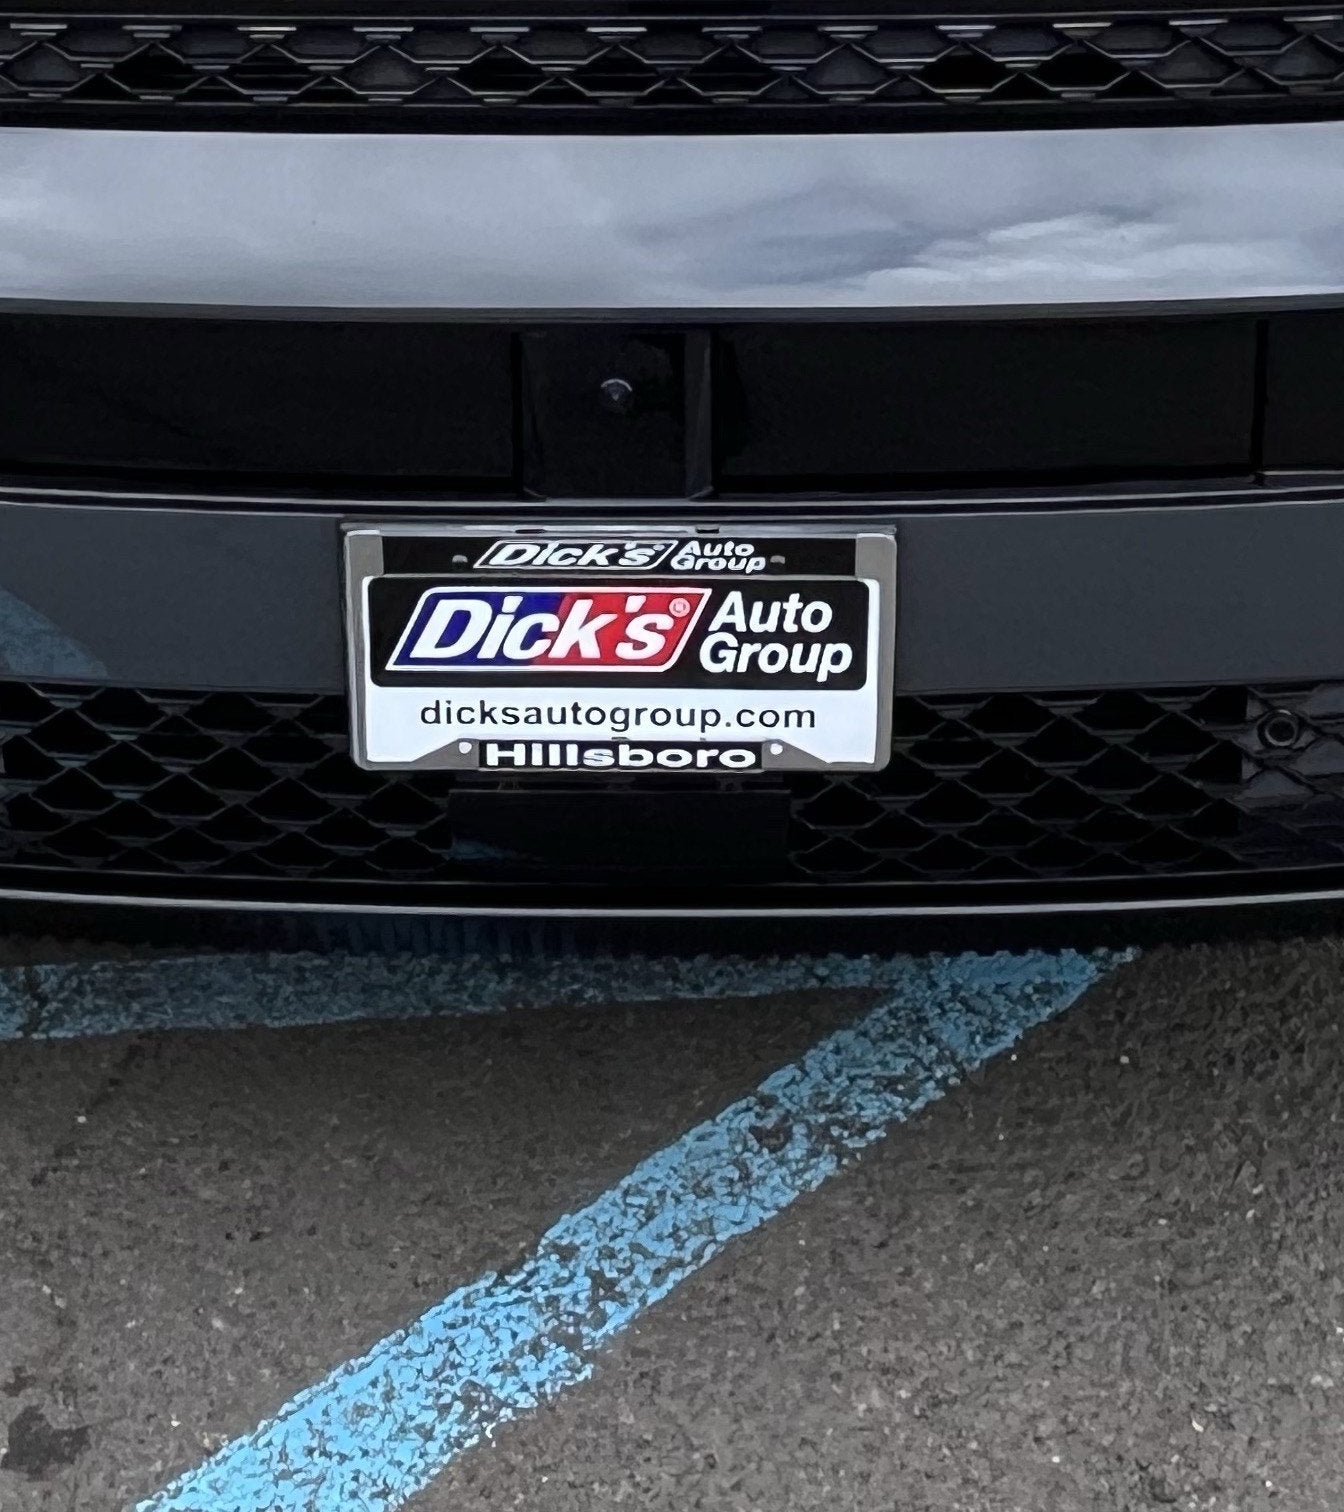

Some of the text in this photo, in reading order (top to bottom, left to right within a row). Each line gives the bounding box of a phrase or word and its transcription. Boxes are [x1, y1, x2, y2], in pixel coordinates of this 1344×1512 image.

[670, 552, 766, 574] Group
[677, 540, 755, 557] Auto
[408, 590, 833, 660] Dick's Auto
[698, 633, 854, 683] Group
[419, 700, 817, 733] dicksautogroup.com
[485, 741, 757, 768] Hillsboro
